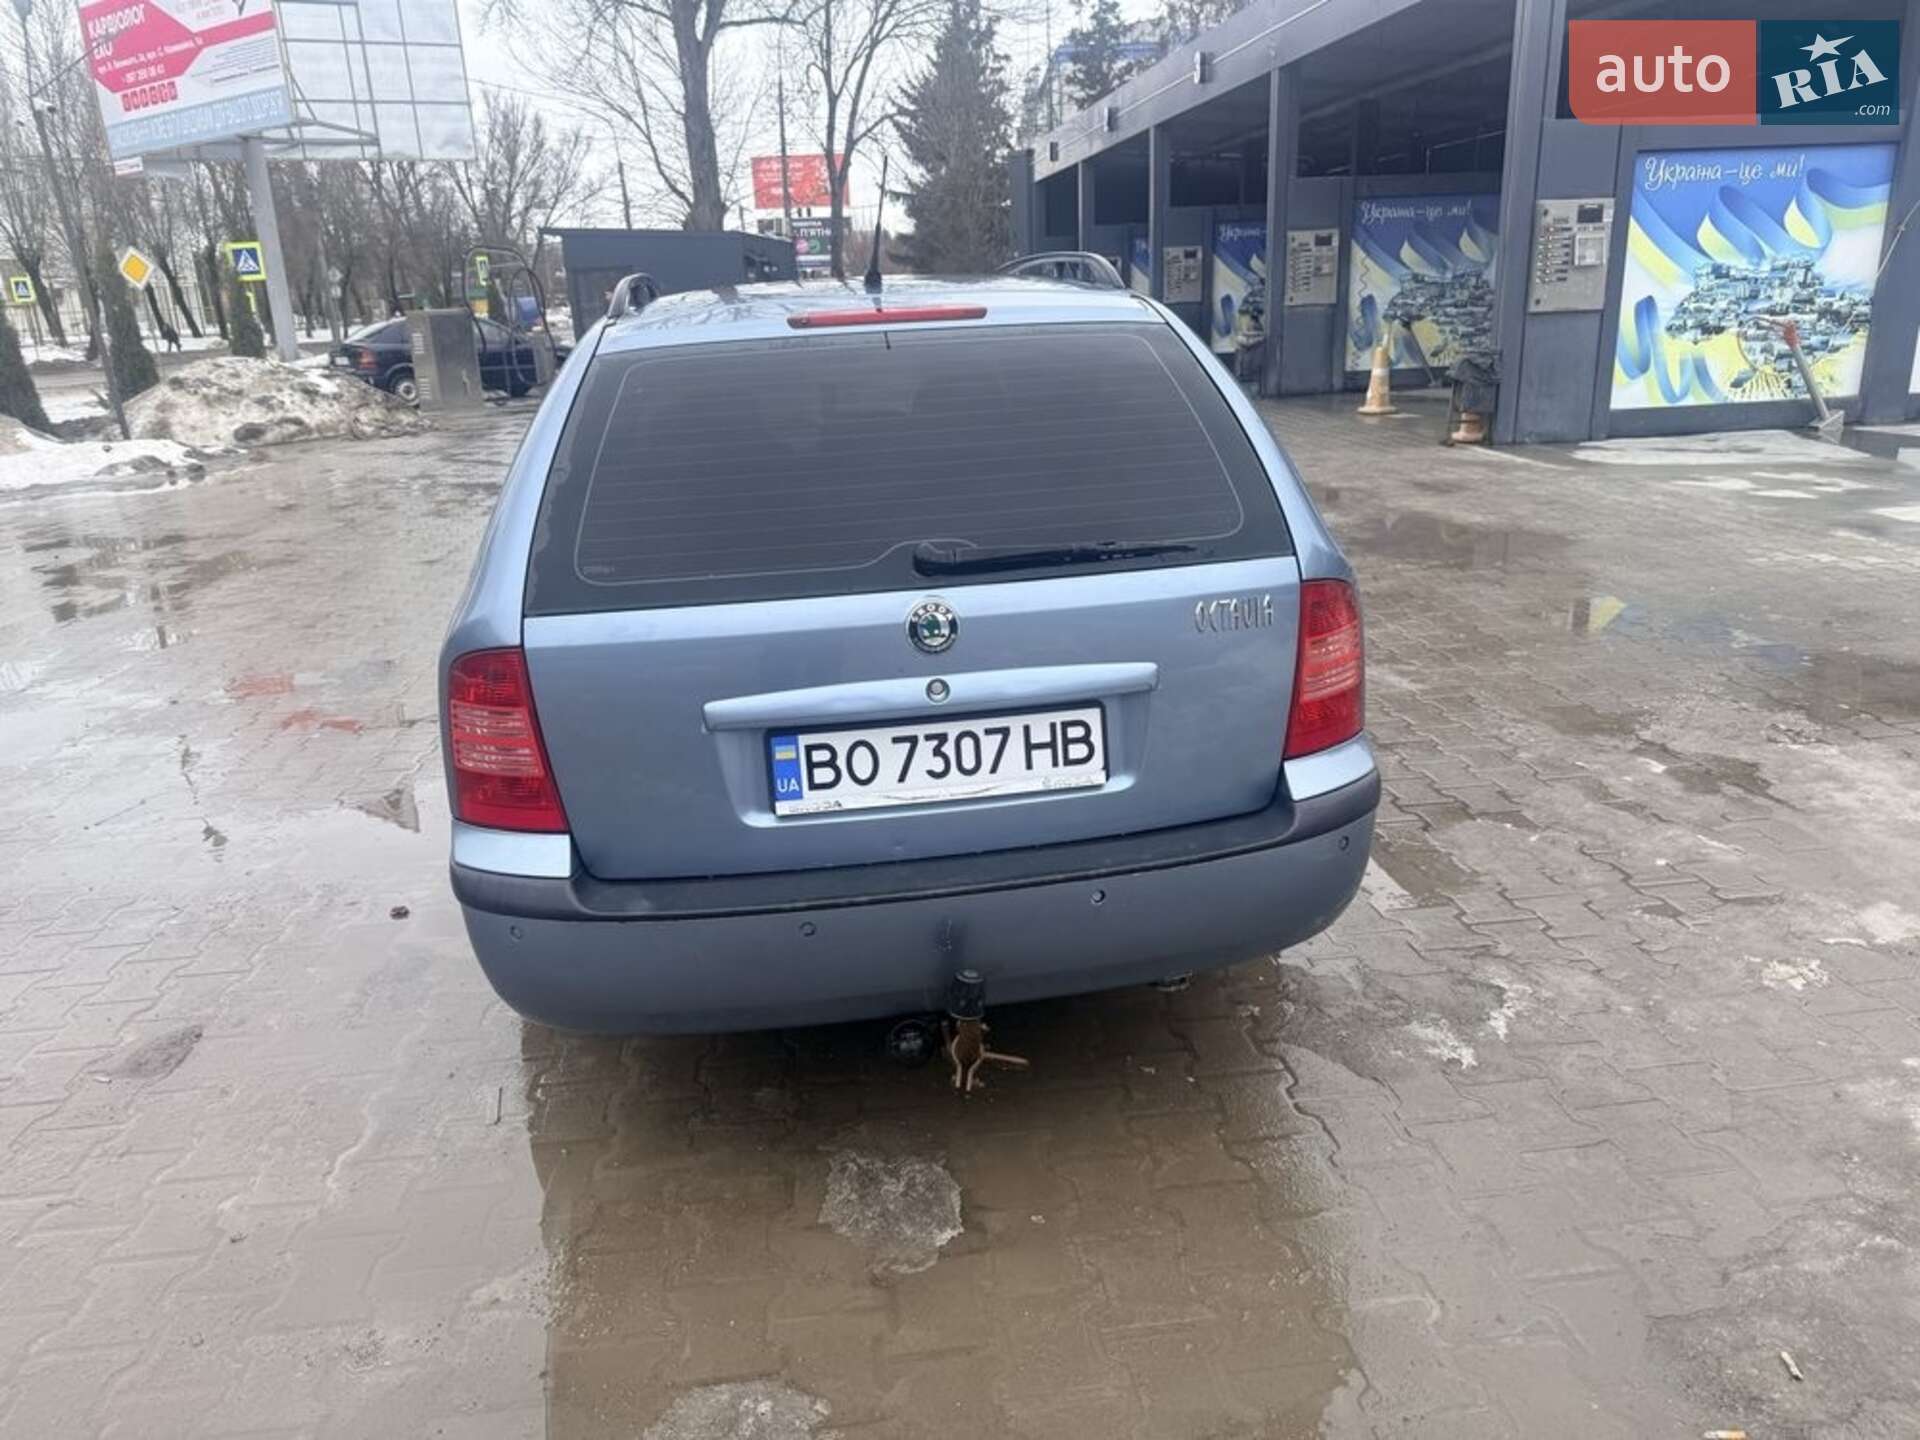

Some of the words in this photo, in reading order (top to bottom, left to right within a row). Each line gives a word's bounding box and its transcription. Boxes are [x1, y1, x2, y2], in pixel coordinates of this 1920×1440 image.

[1770, 154, 1806, 178] ми!
[804, 739, 881, 792] BO
[891, 726, 1012, 784] 7307
[1022, 719, 1096, 771] HB
[776, 777, 800, 794] UA
